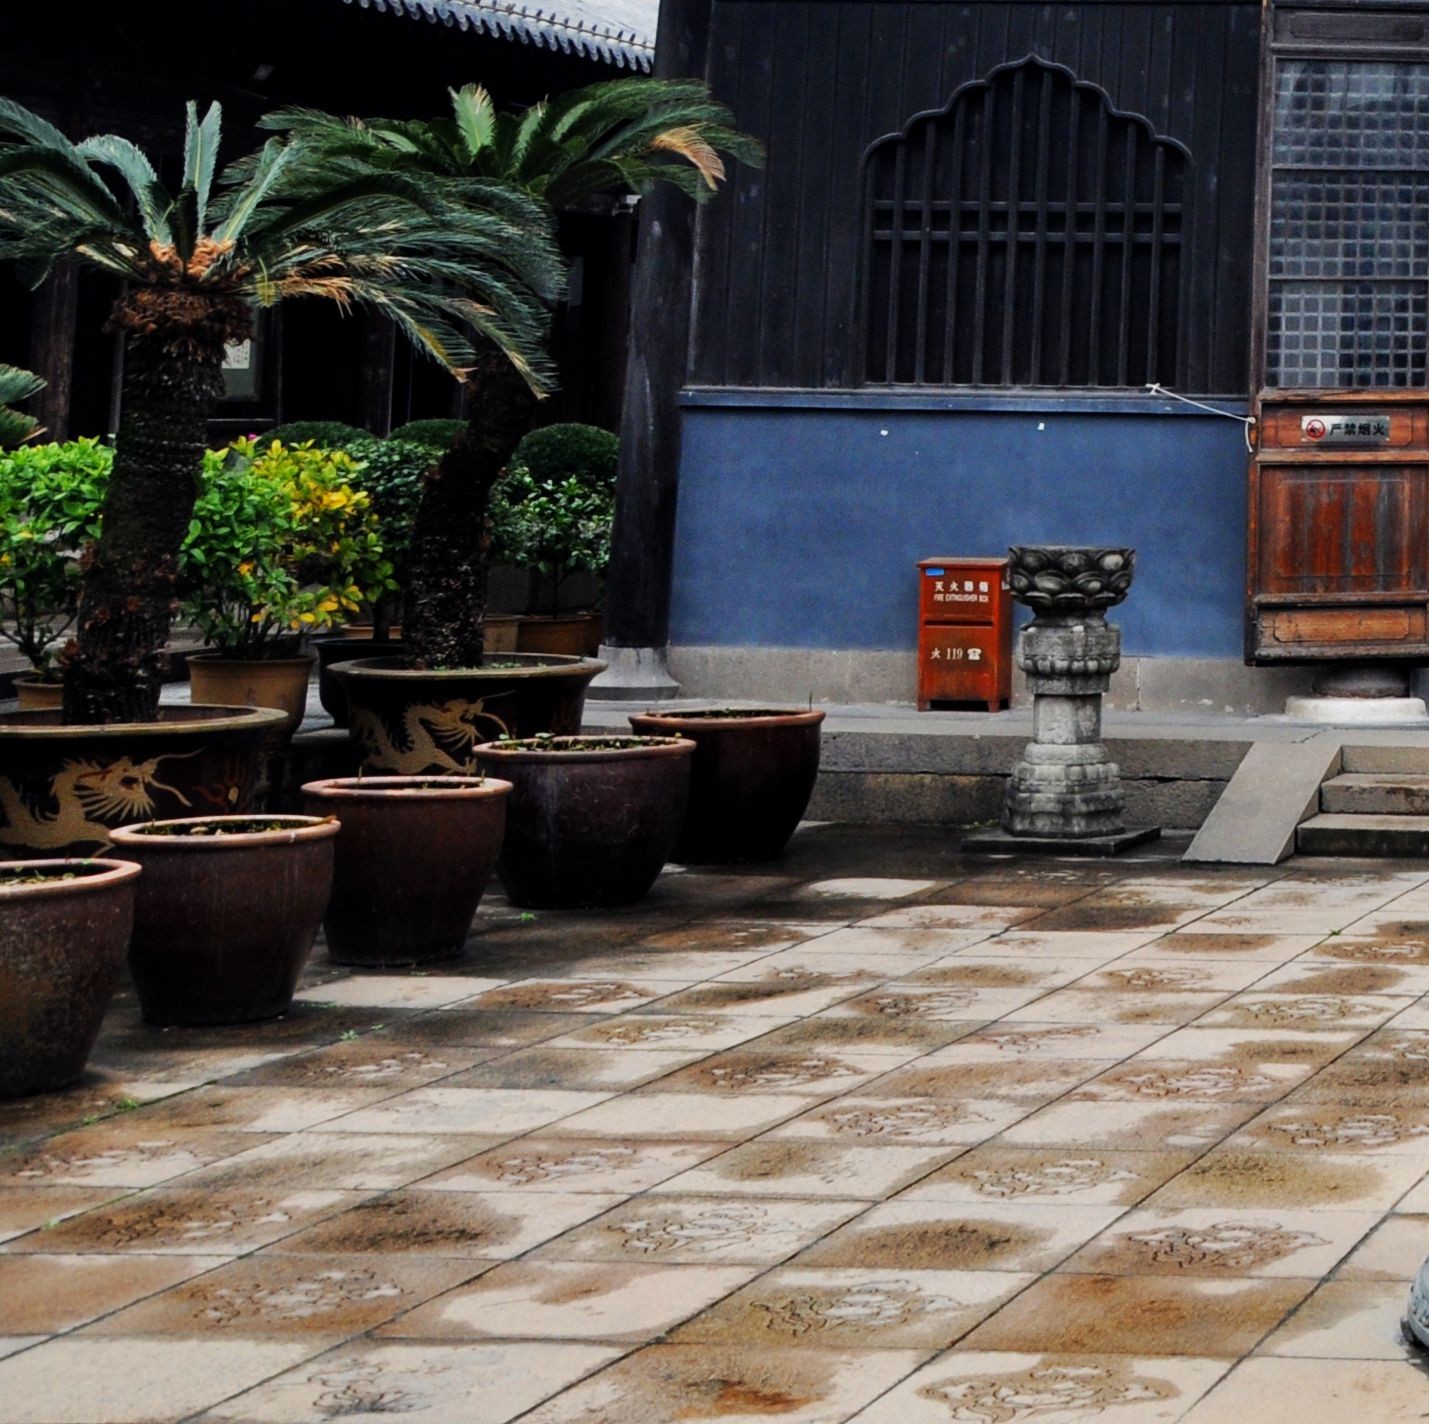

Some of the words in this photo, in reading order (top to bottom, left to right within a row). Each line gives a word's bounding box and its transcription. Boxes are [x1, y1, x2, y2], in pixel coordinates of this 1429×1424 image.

[1329, 422, 1385, 436] 严禁烟火
[935, 580, 989, 593] 灭火器箱
[946, 647, 963, 660] 119
